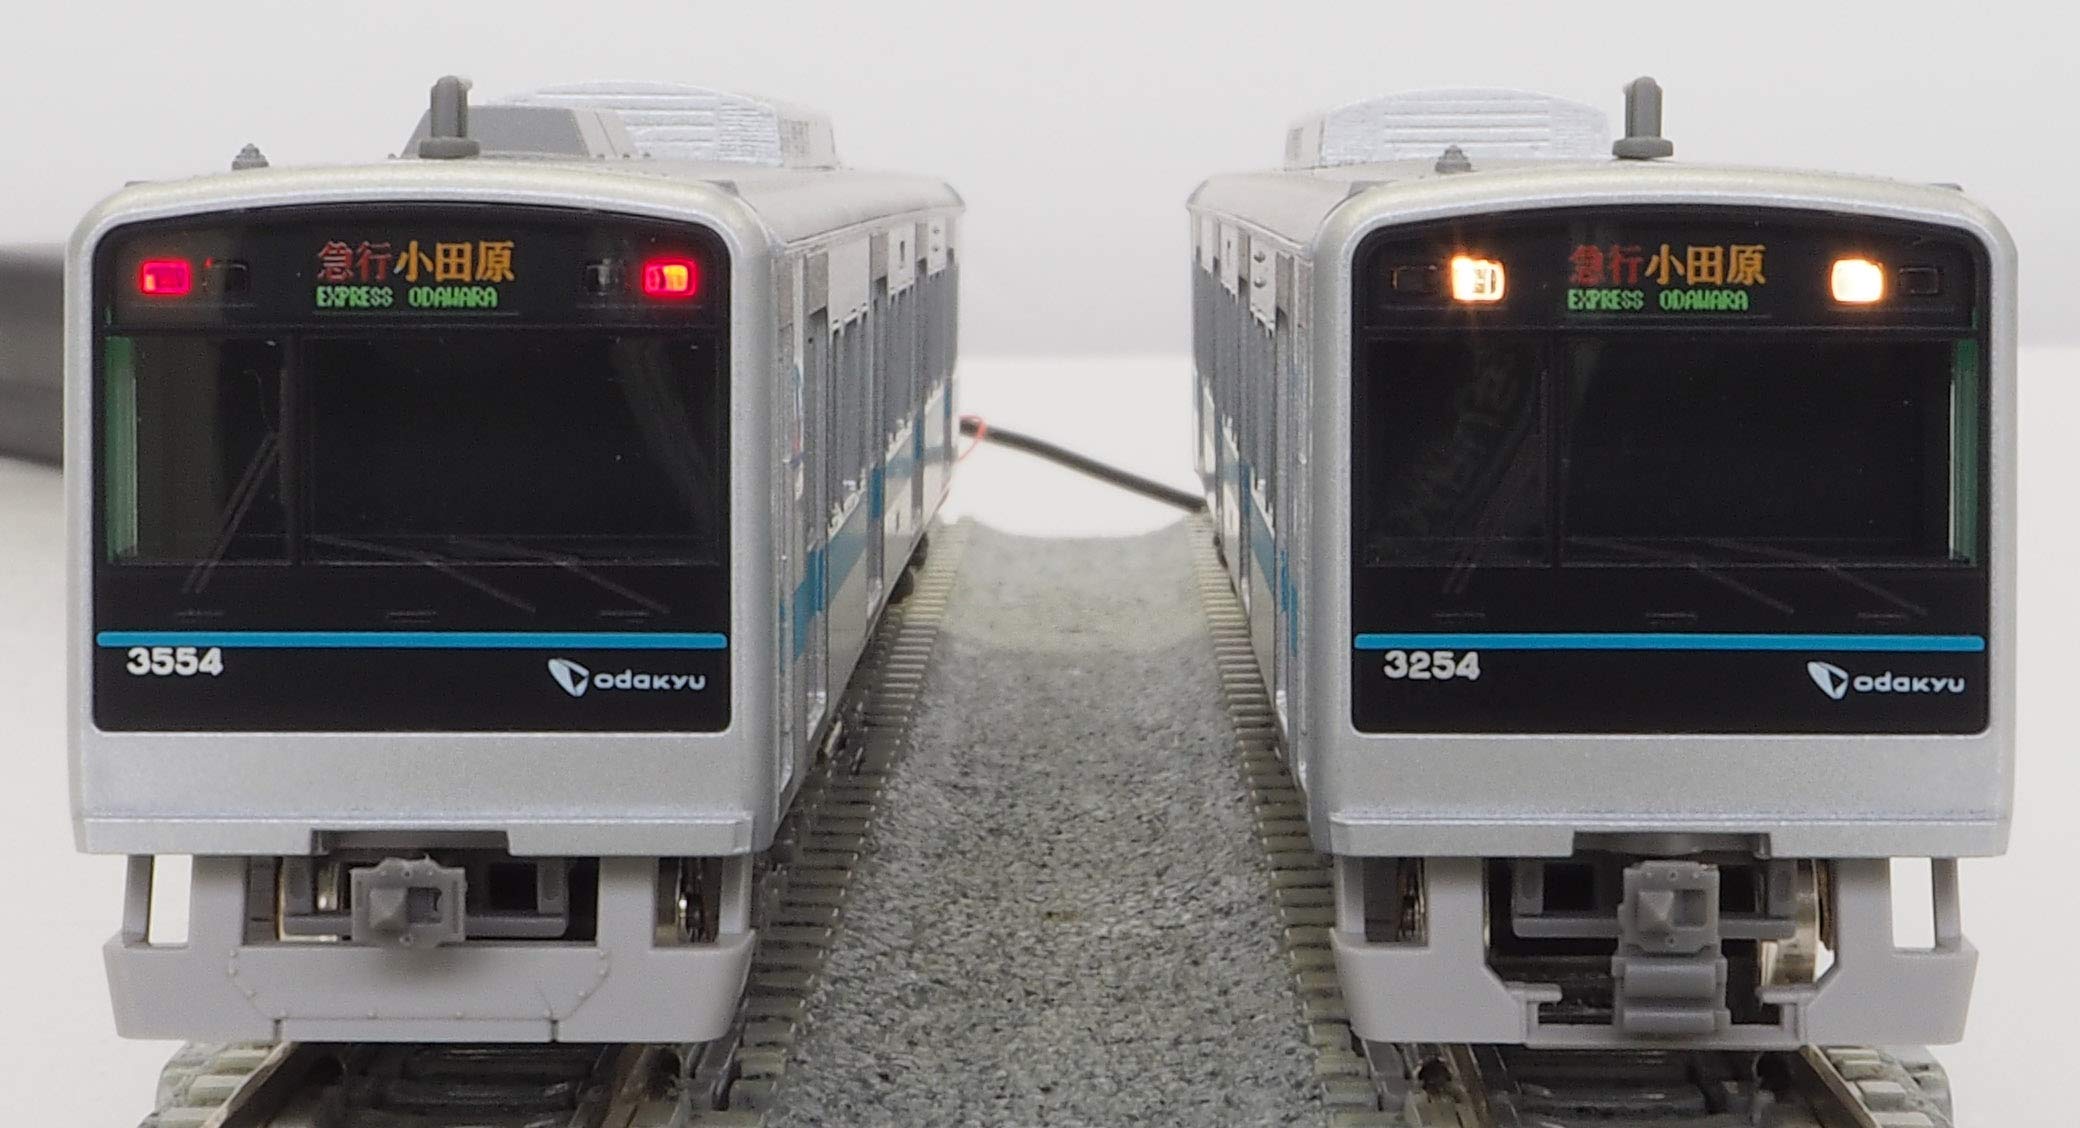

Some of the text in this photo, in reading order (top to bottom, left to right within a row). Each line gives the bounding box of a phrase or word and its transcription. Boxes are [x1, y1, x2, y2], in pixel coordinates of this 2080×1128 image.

[316, 286, 498, 308] EXPRESS ODAWARA
[1567, 289, 1749, 311] EXPRESS ODAWARA
[126, 647, 224, 676] 3554
[1383, 650, 1481, 680] 3254
